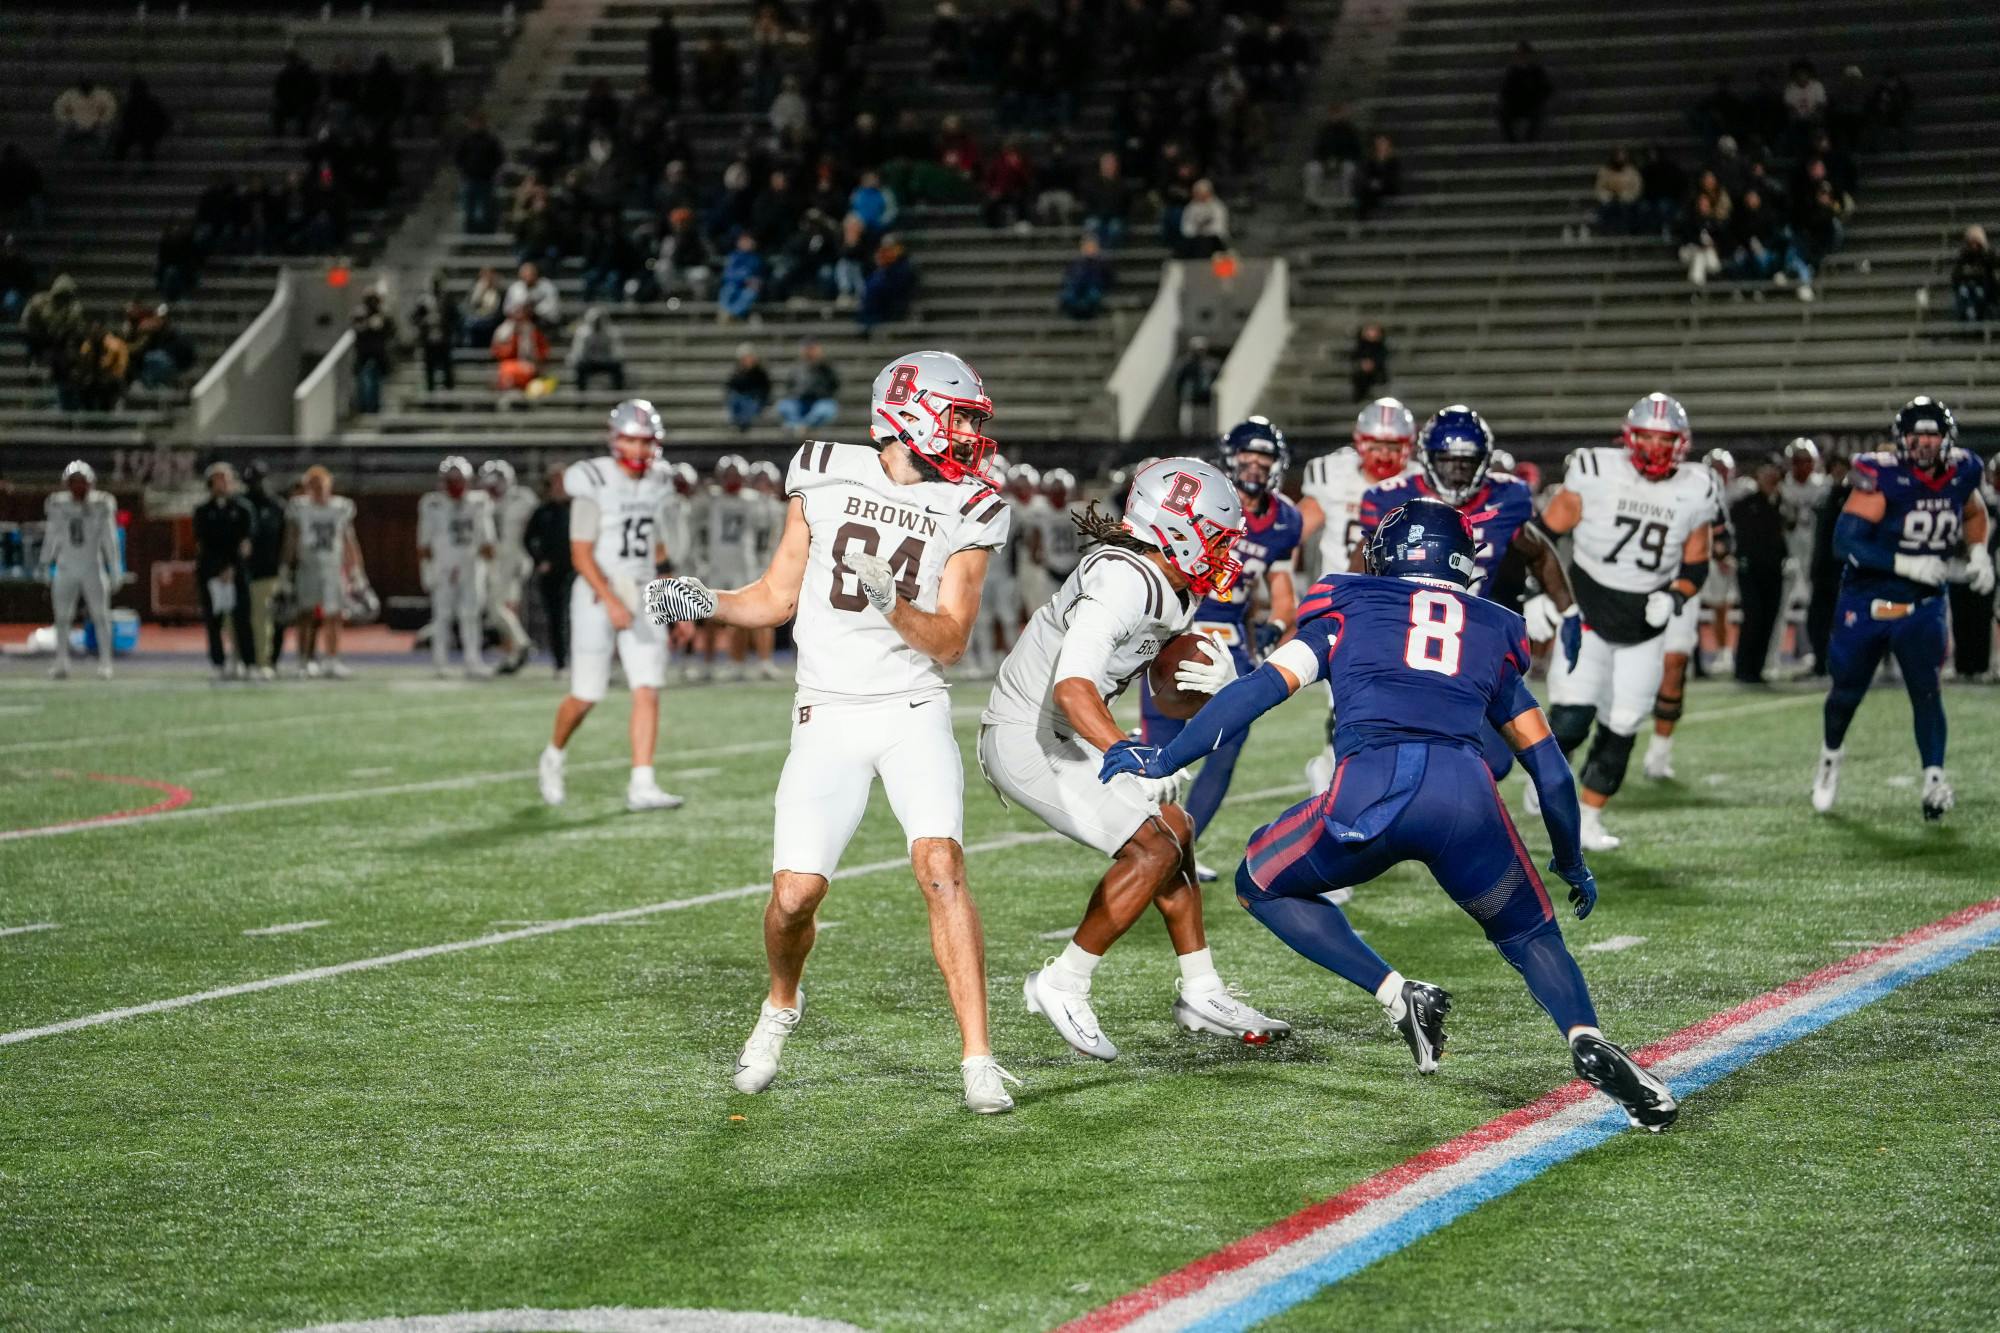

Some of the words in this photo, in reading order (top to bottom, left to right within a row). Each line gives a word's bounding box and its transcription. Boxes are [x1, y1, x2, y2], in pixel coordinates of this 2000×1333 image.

[885, 365, 919, 406] B
[1161, 471, 1202, 516] B
[1617, 499, 1675, 520] BROWN
[619, 517, 654, 557] 15
[843, 496, 937, 537] BROWN
[1899, 510, 1958, 550] 90
[1451, 554, 1460, 567] VD
[1603, 515, 1669, 572] 79
[829, 521, 926, 613] 84
[1403, 589, 1466, 678] 8
[799, 705, 812, 725] B
